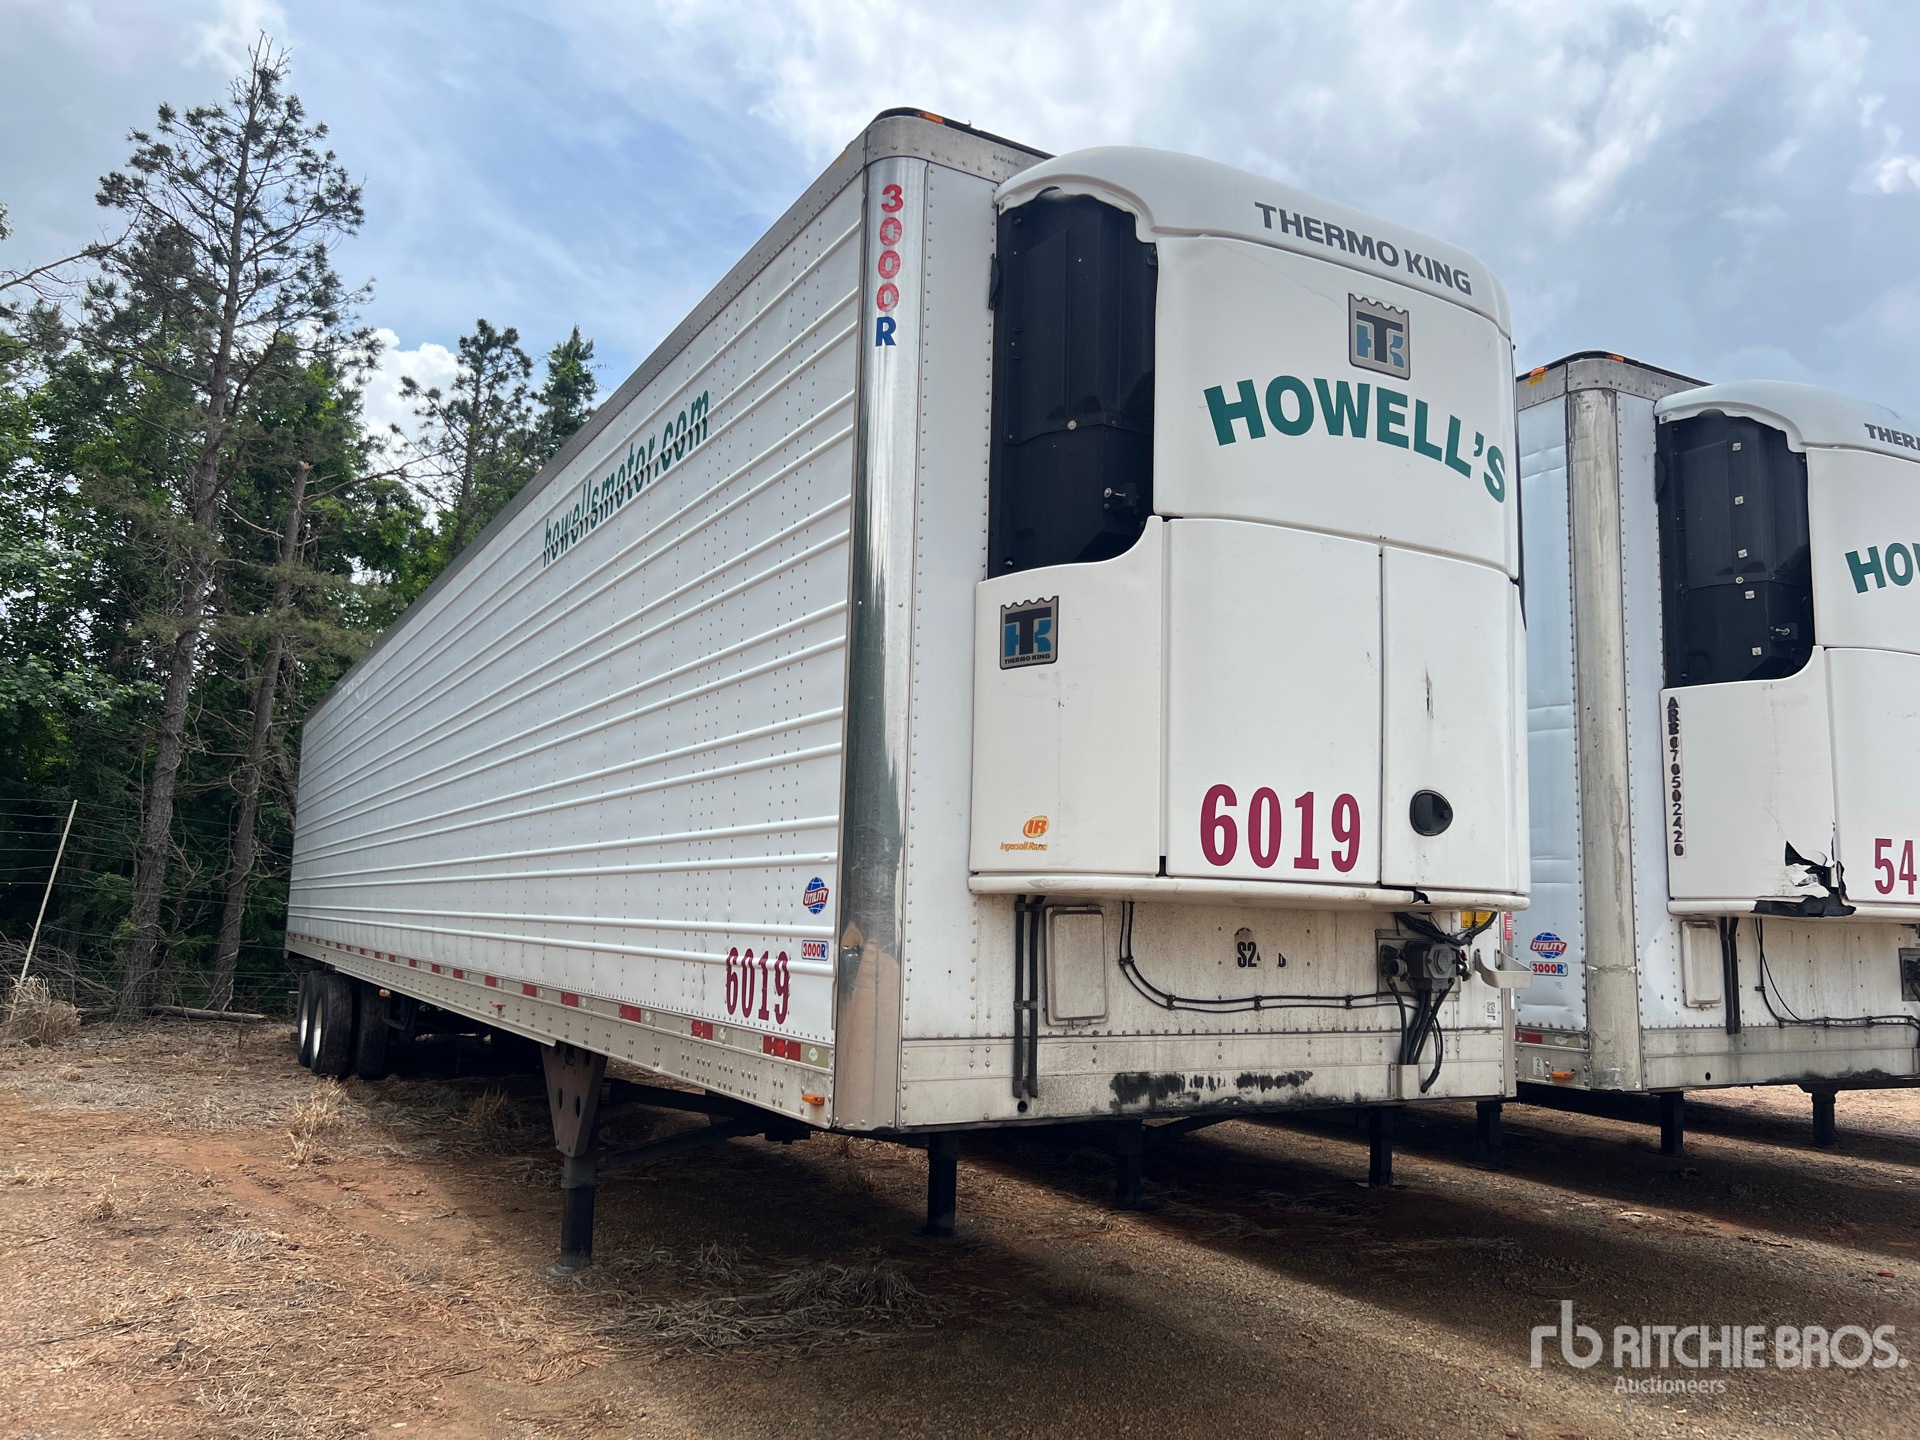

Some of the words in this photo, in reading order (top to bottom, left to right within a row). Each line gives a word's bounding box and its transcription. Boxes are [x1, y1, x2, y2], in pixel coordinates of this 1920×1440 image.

[875, 183, 904, 348] 3000R
[1254, 201, 1400, 268] THERMO
[1404, 248, 1472, 296] KING
[1203, 374, 1506, 504] HOWELL'S
[543, 389, 709, 568] howellsmotor.com
[1845, 542, 1920, 594] HO
[1004, 655, 1031, 665] THERMO
[1032, 653, 1051, 661] KING
[1200, 783, 1361, 873] 6019
[804, 889, 828, 904] UTILITY
[802, 942, 826, 958] 3000R
[1531, 941, 1565, 951] UTILITY
[1532, 962, 1564, 975] 3000R
[726, 947, 790, 1025] 6019
